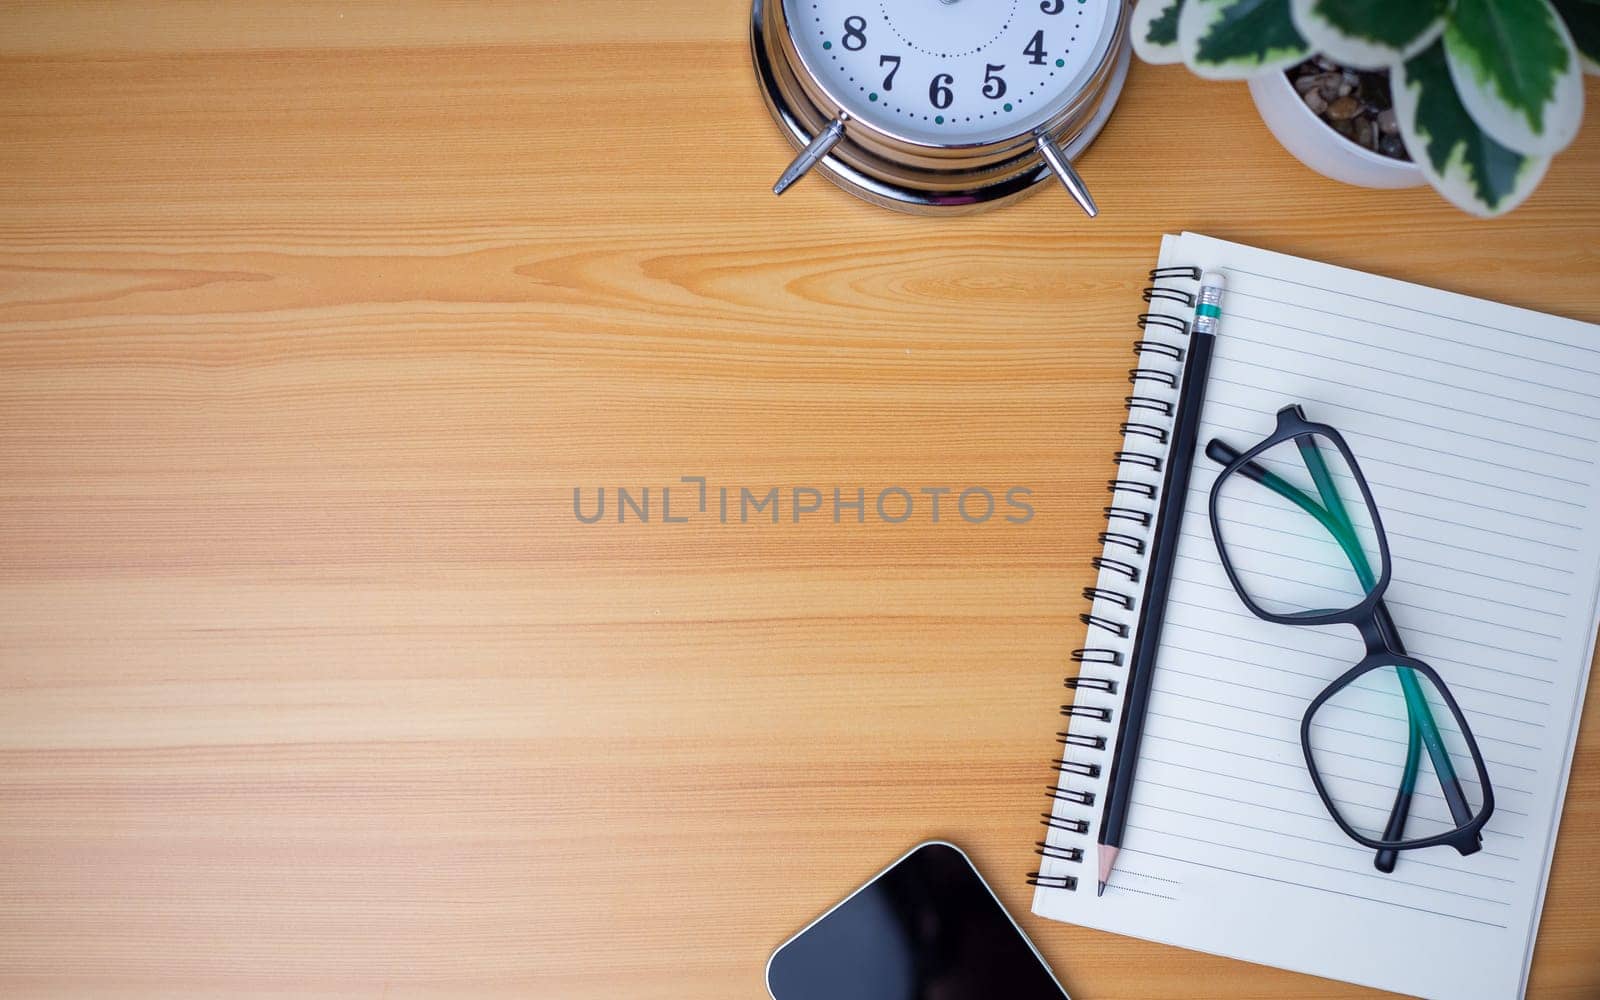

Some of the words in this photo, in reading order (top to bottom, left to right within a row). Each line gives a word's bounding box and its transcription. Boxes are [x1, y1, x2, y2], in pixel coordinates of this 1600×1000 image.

[841, 15, 867, 51] 8
[1022, 29, 1048, 65] 4
[879, 54, 902, 91] 7
[981, 63, 1008, 99] 5
[928, 73, 954, 109] 6
